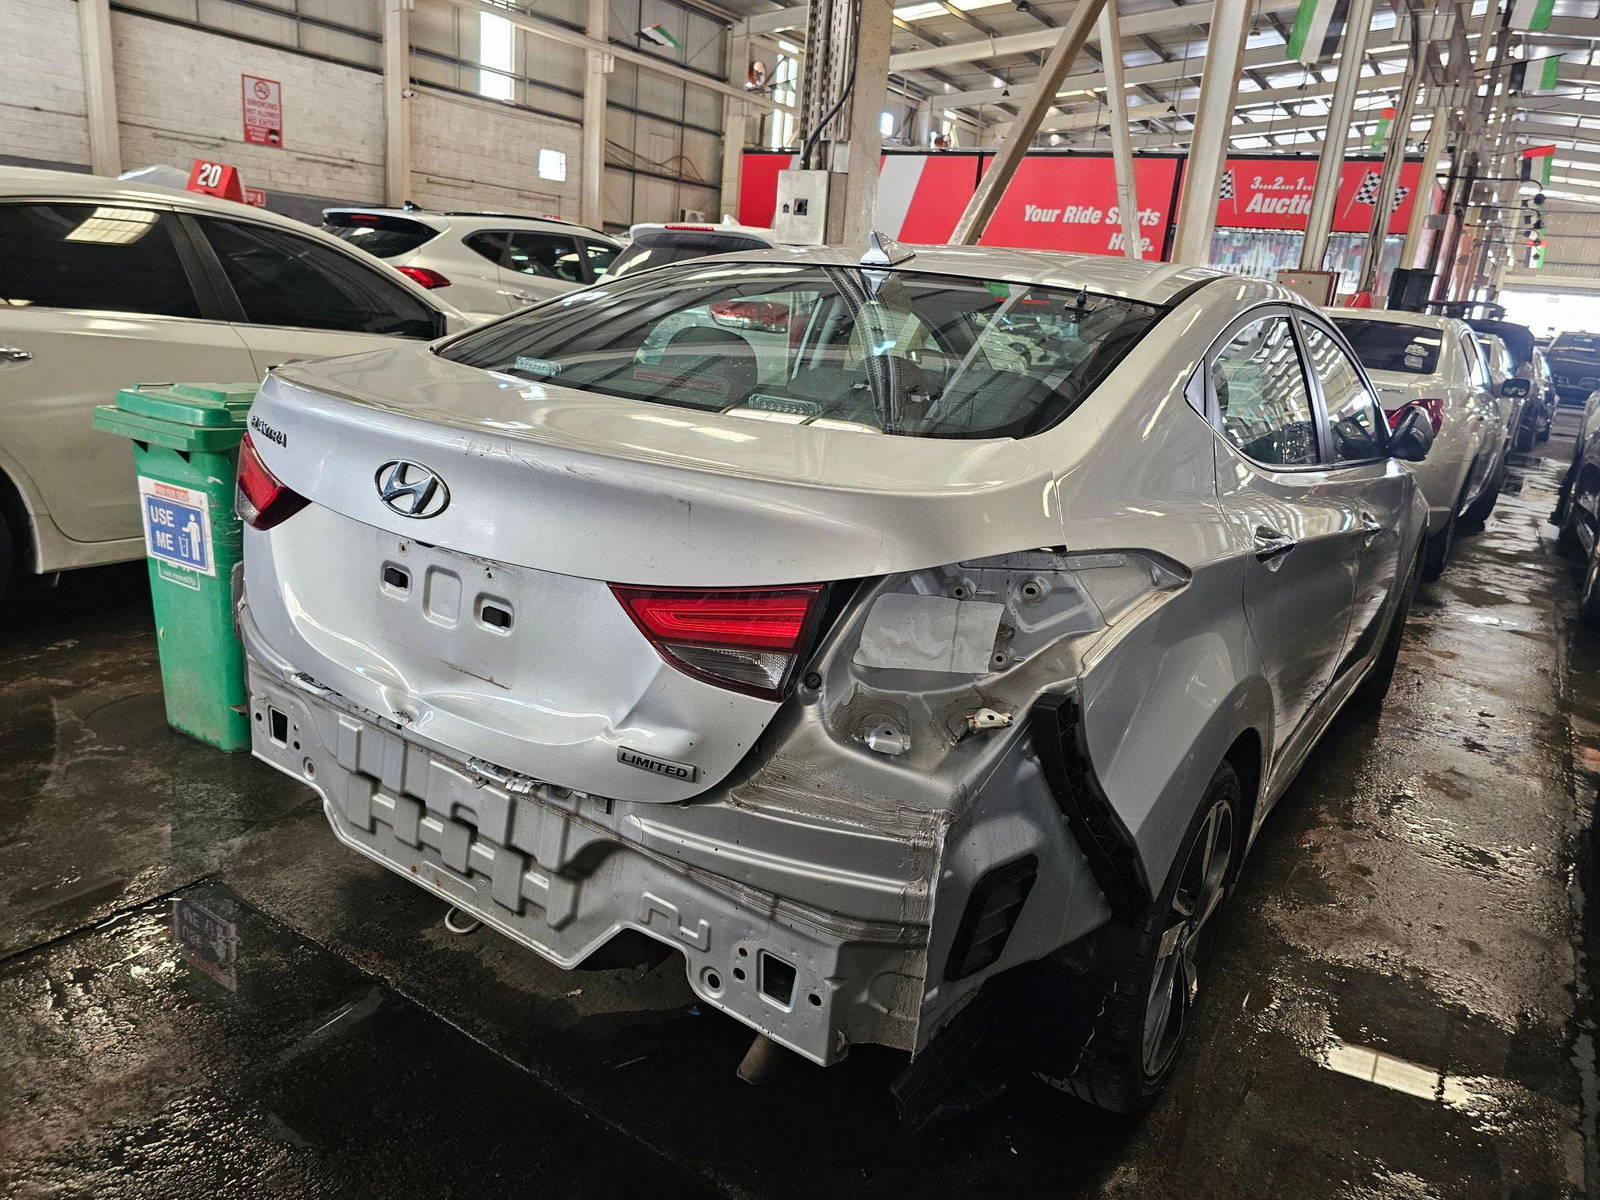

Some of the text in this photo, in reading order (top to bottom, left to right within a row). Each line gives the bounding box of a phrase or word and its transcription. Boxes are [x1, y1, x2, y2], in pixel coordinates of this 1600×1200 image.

[197, 162, 222, 187] 20
[1024, 204, 1160, 226] Your Ride Srts
[1108, 232, 1154, 252] He.
[150, 505, 175, 528] USE
[156, 530, 175, 551] ME
[621, 752, 688, 778] LIMITED
